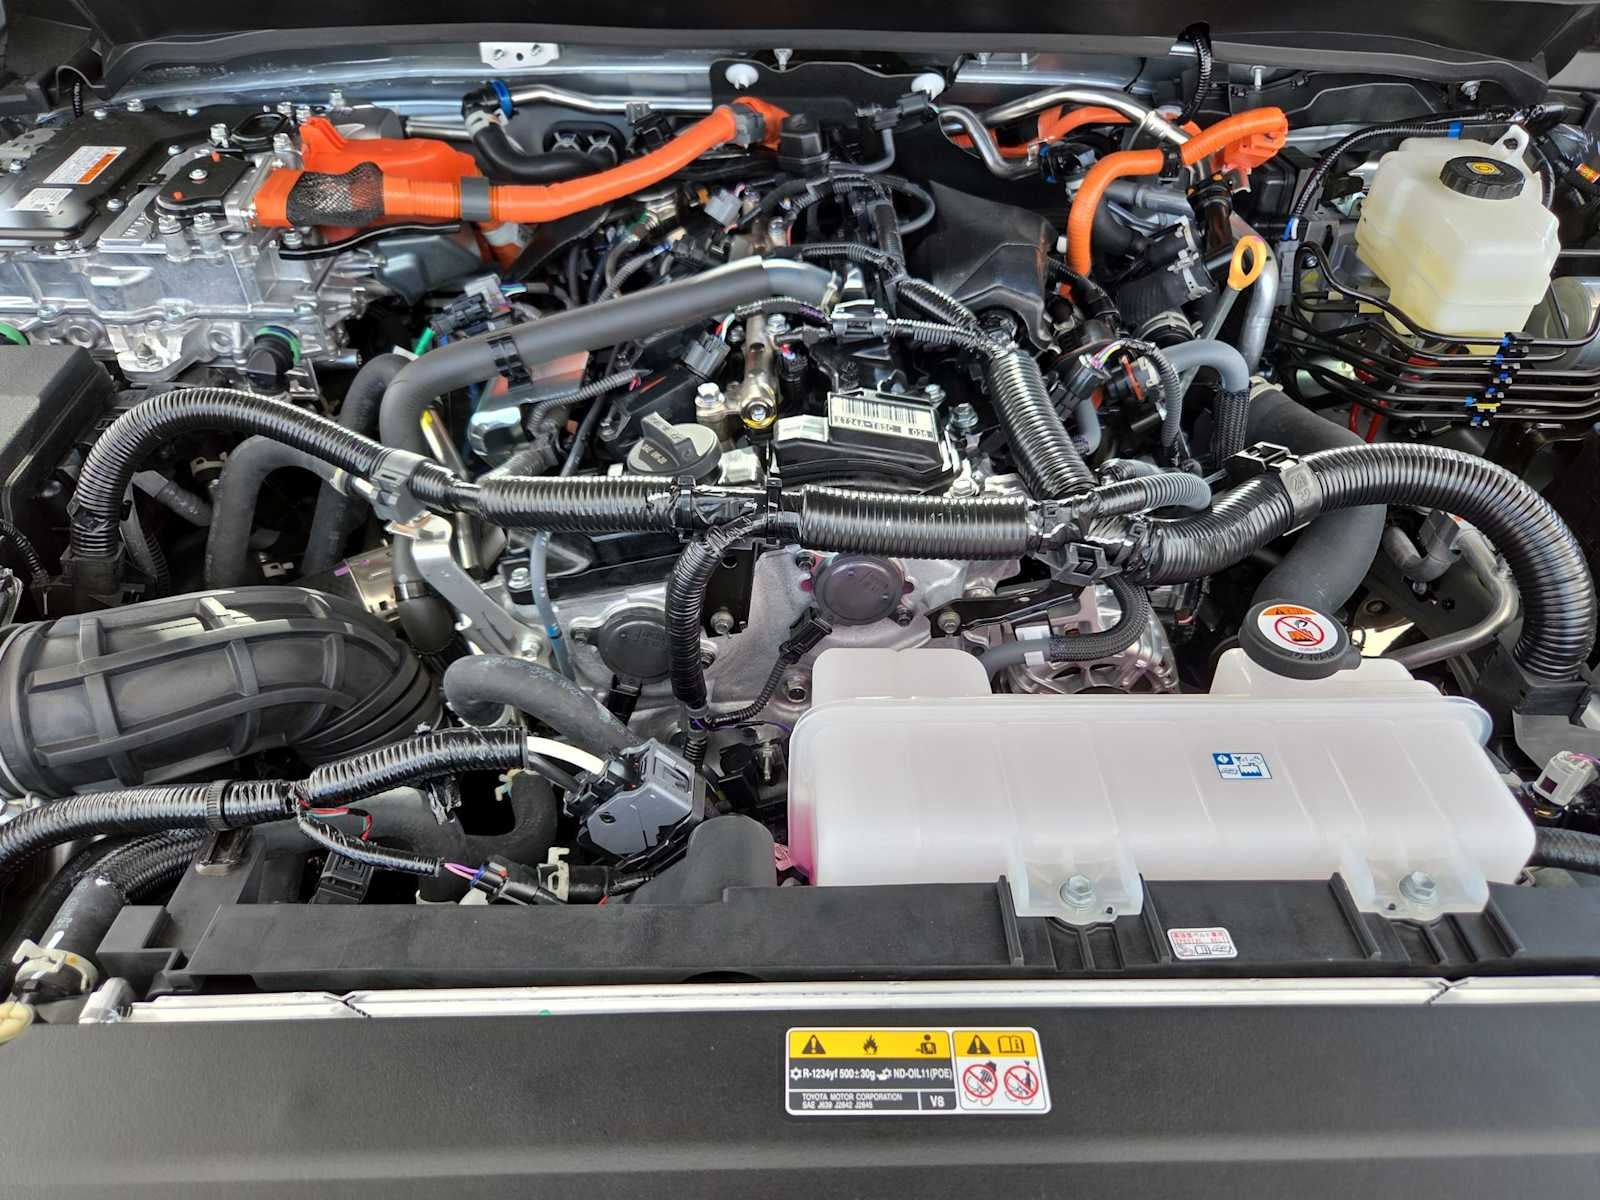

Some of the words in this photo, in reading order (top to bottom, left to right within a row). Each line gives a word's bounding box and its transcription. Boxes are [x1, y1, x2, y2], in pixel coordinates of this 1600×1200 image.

[802, 1068, 838, 1081] R-1234yf
[839, 1068, 876, 1081] 500±30g
[802, 1093, 828, 1101] TOYOTA
[830, 1093, 854, 1101] MOTOR
[855, 1093, 903, 1101] CORPORATION
[802, 1101, 815, 1109] SAE
